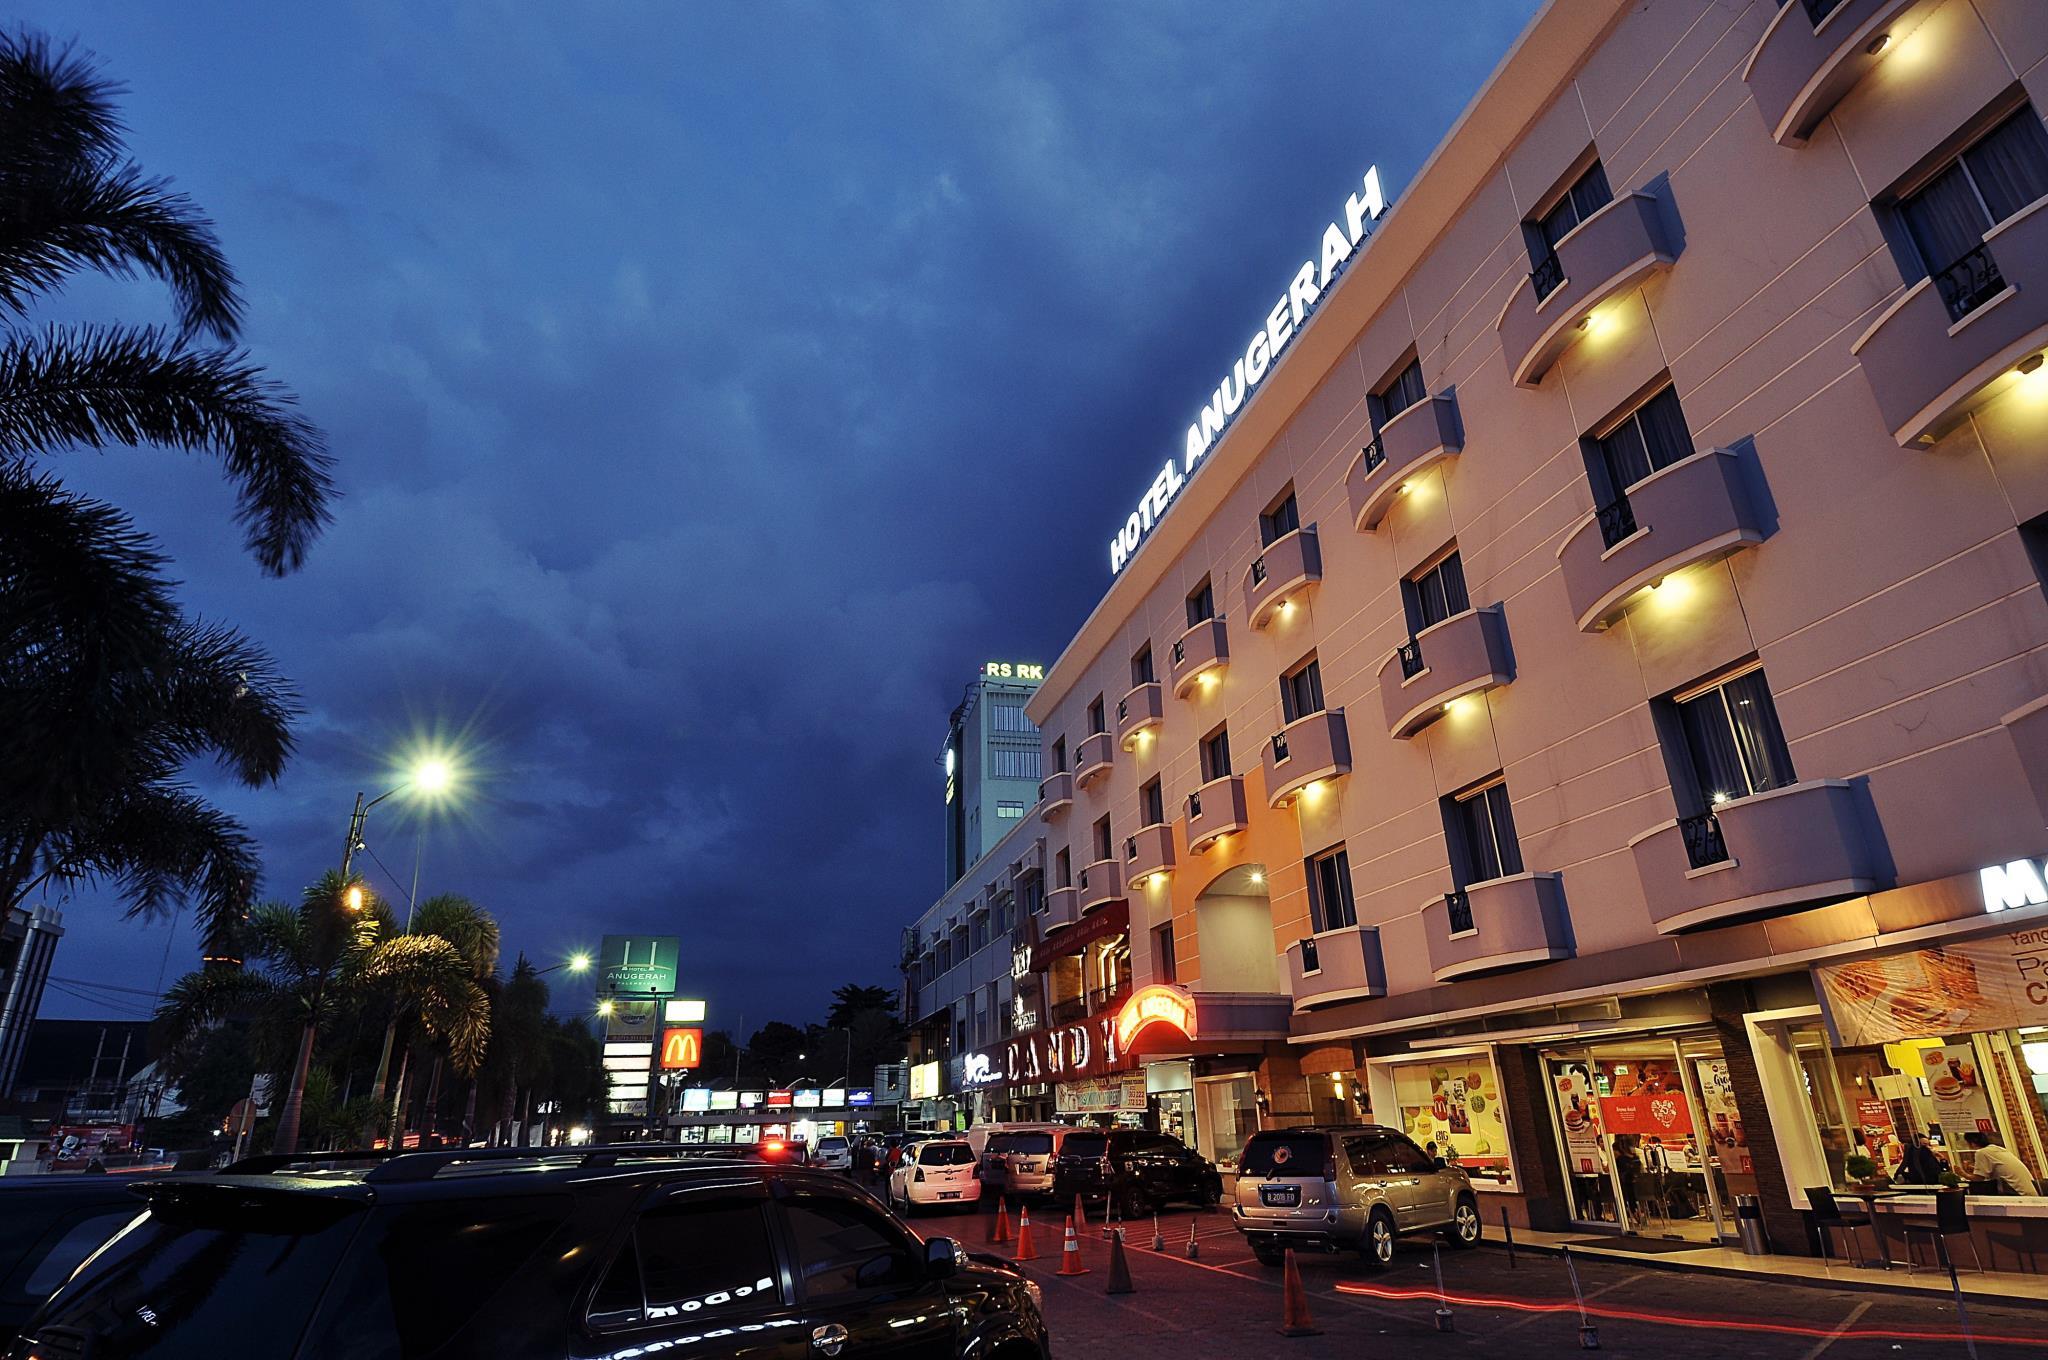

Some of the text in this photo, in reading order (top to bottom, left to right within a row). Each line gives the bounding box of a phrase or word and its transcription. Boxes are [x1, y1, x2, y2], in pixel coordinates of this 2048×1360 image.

[1110, 163, 1385, 575] HOTEL ANUGERAH
[987, 662, 1044, 680] RS RK
[1978, 857, 2048, 914] M
[606, 972, 666, 981] ANUGERAH
[1006, 1017, 1118, 1081] CANDY
[1435, 1130, 1449, 1141] BIG
